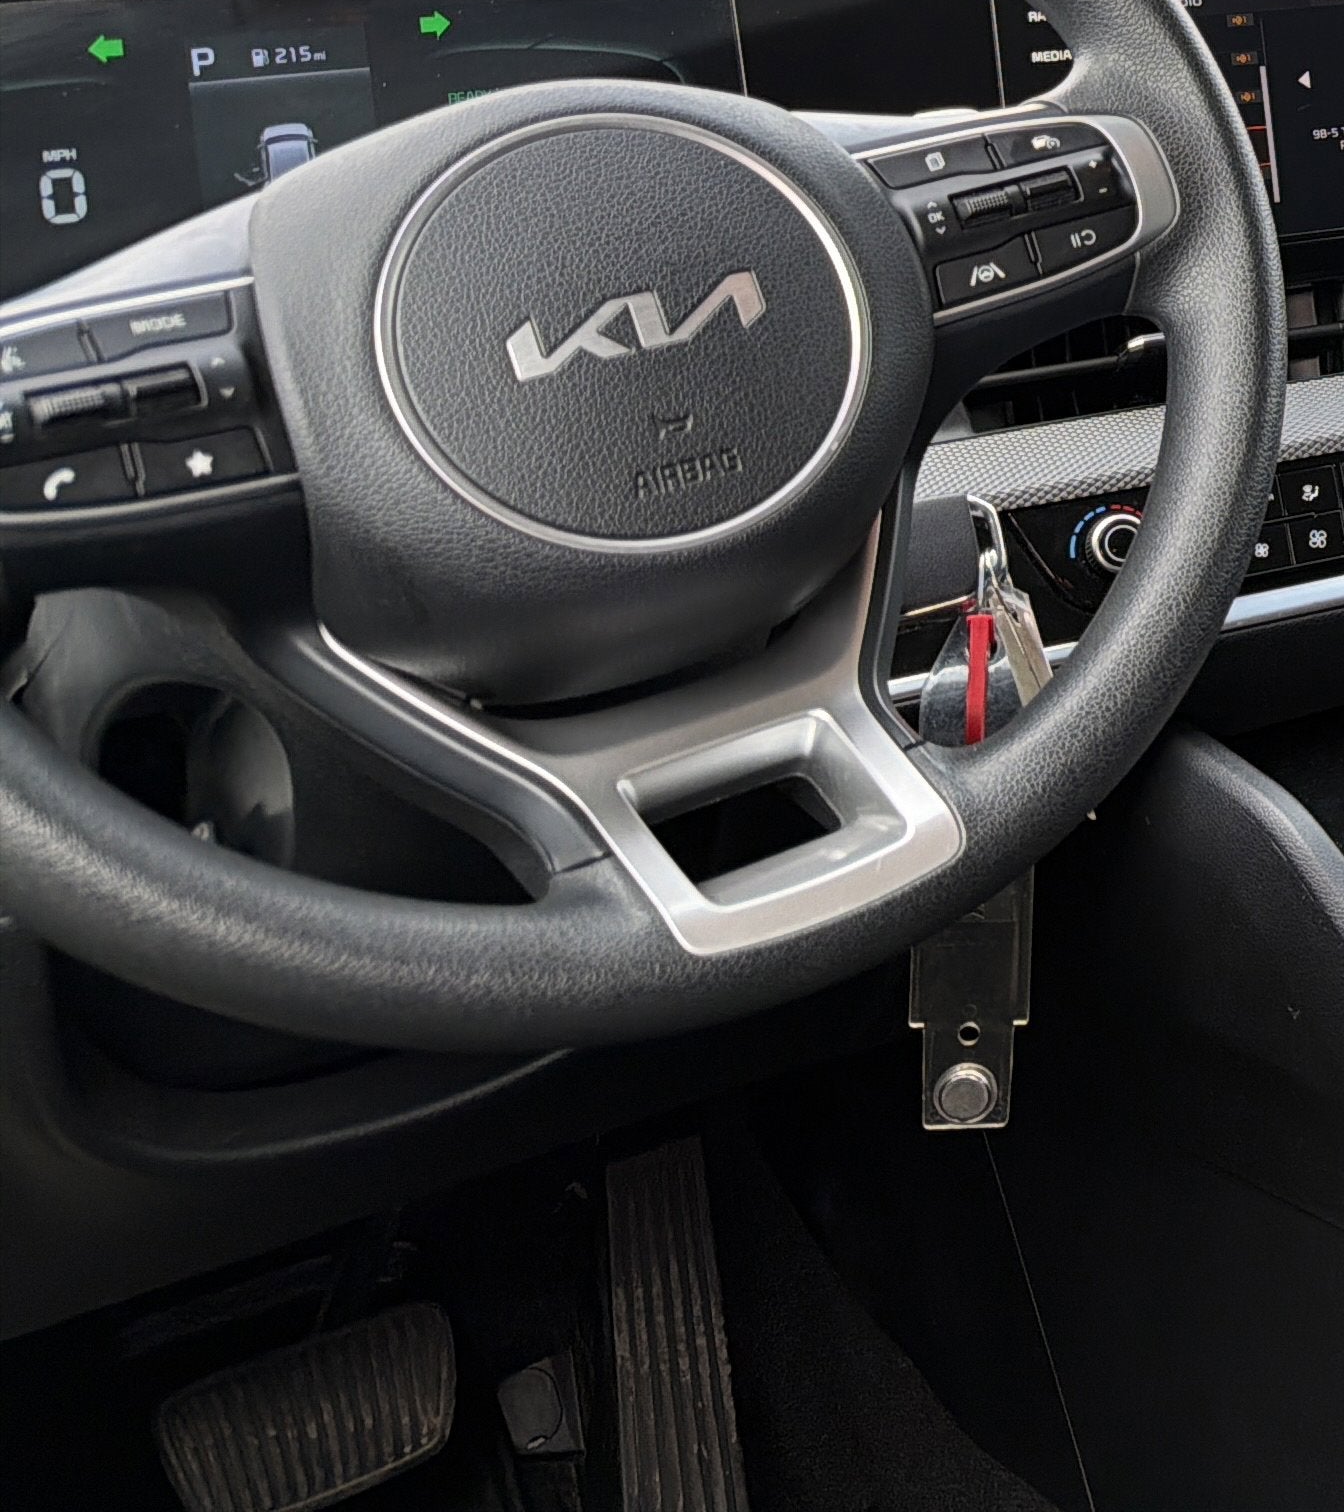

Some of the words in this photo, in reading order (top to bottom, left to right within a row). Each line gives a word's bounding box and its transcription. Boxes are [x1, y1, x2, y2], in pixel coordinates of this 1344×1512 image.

[191, 47, 215, 77] P
[275, 45, 312, 64] 215
[313, 50, 327, 61] mi
[1031, 50, 1073, 63] MEDIA
[1312, 126, 1339, 140] 98-5
[42, 148, 77, 163] MPH
[39, 167, 88, 226] 0
[928, 211, 945, 224] OK
[129, 313, 187, 336] MODE
[506, 270, 767, 383] KIA
[636, 446, 743, 499] AIRBAG
